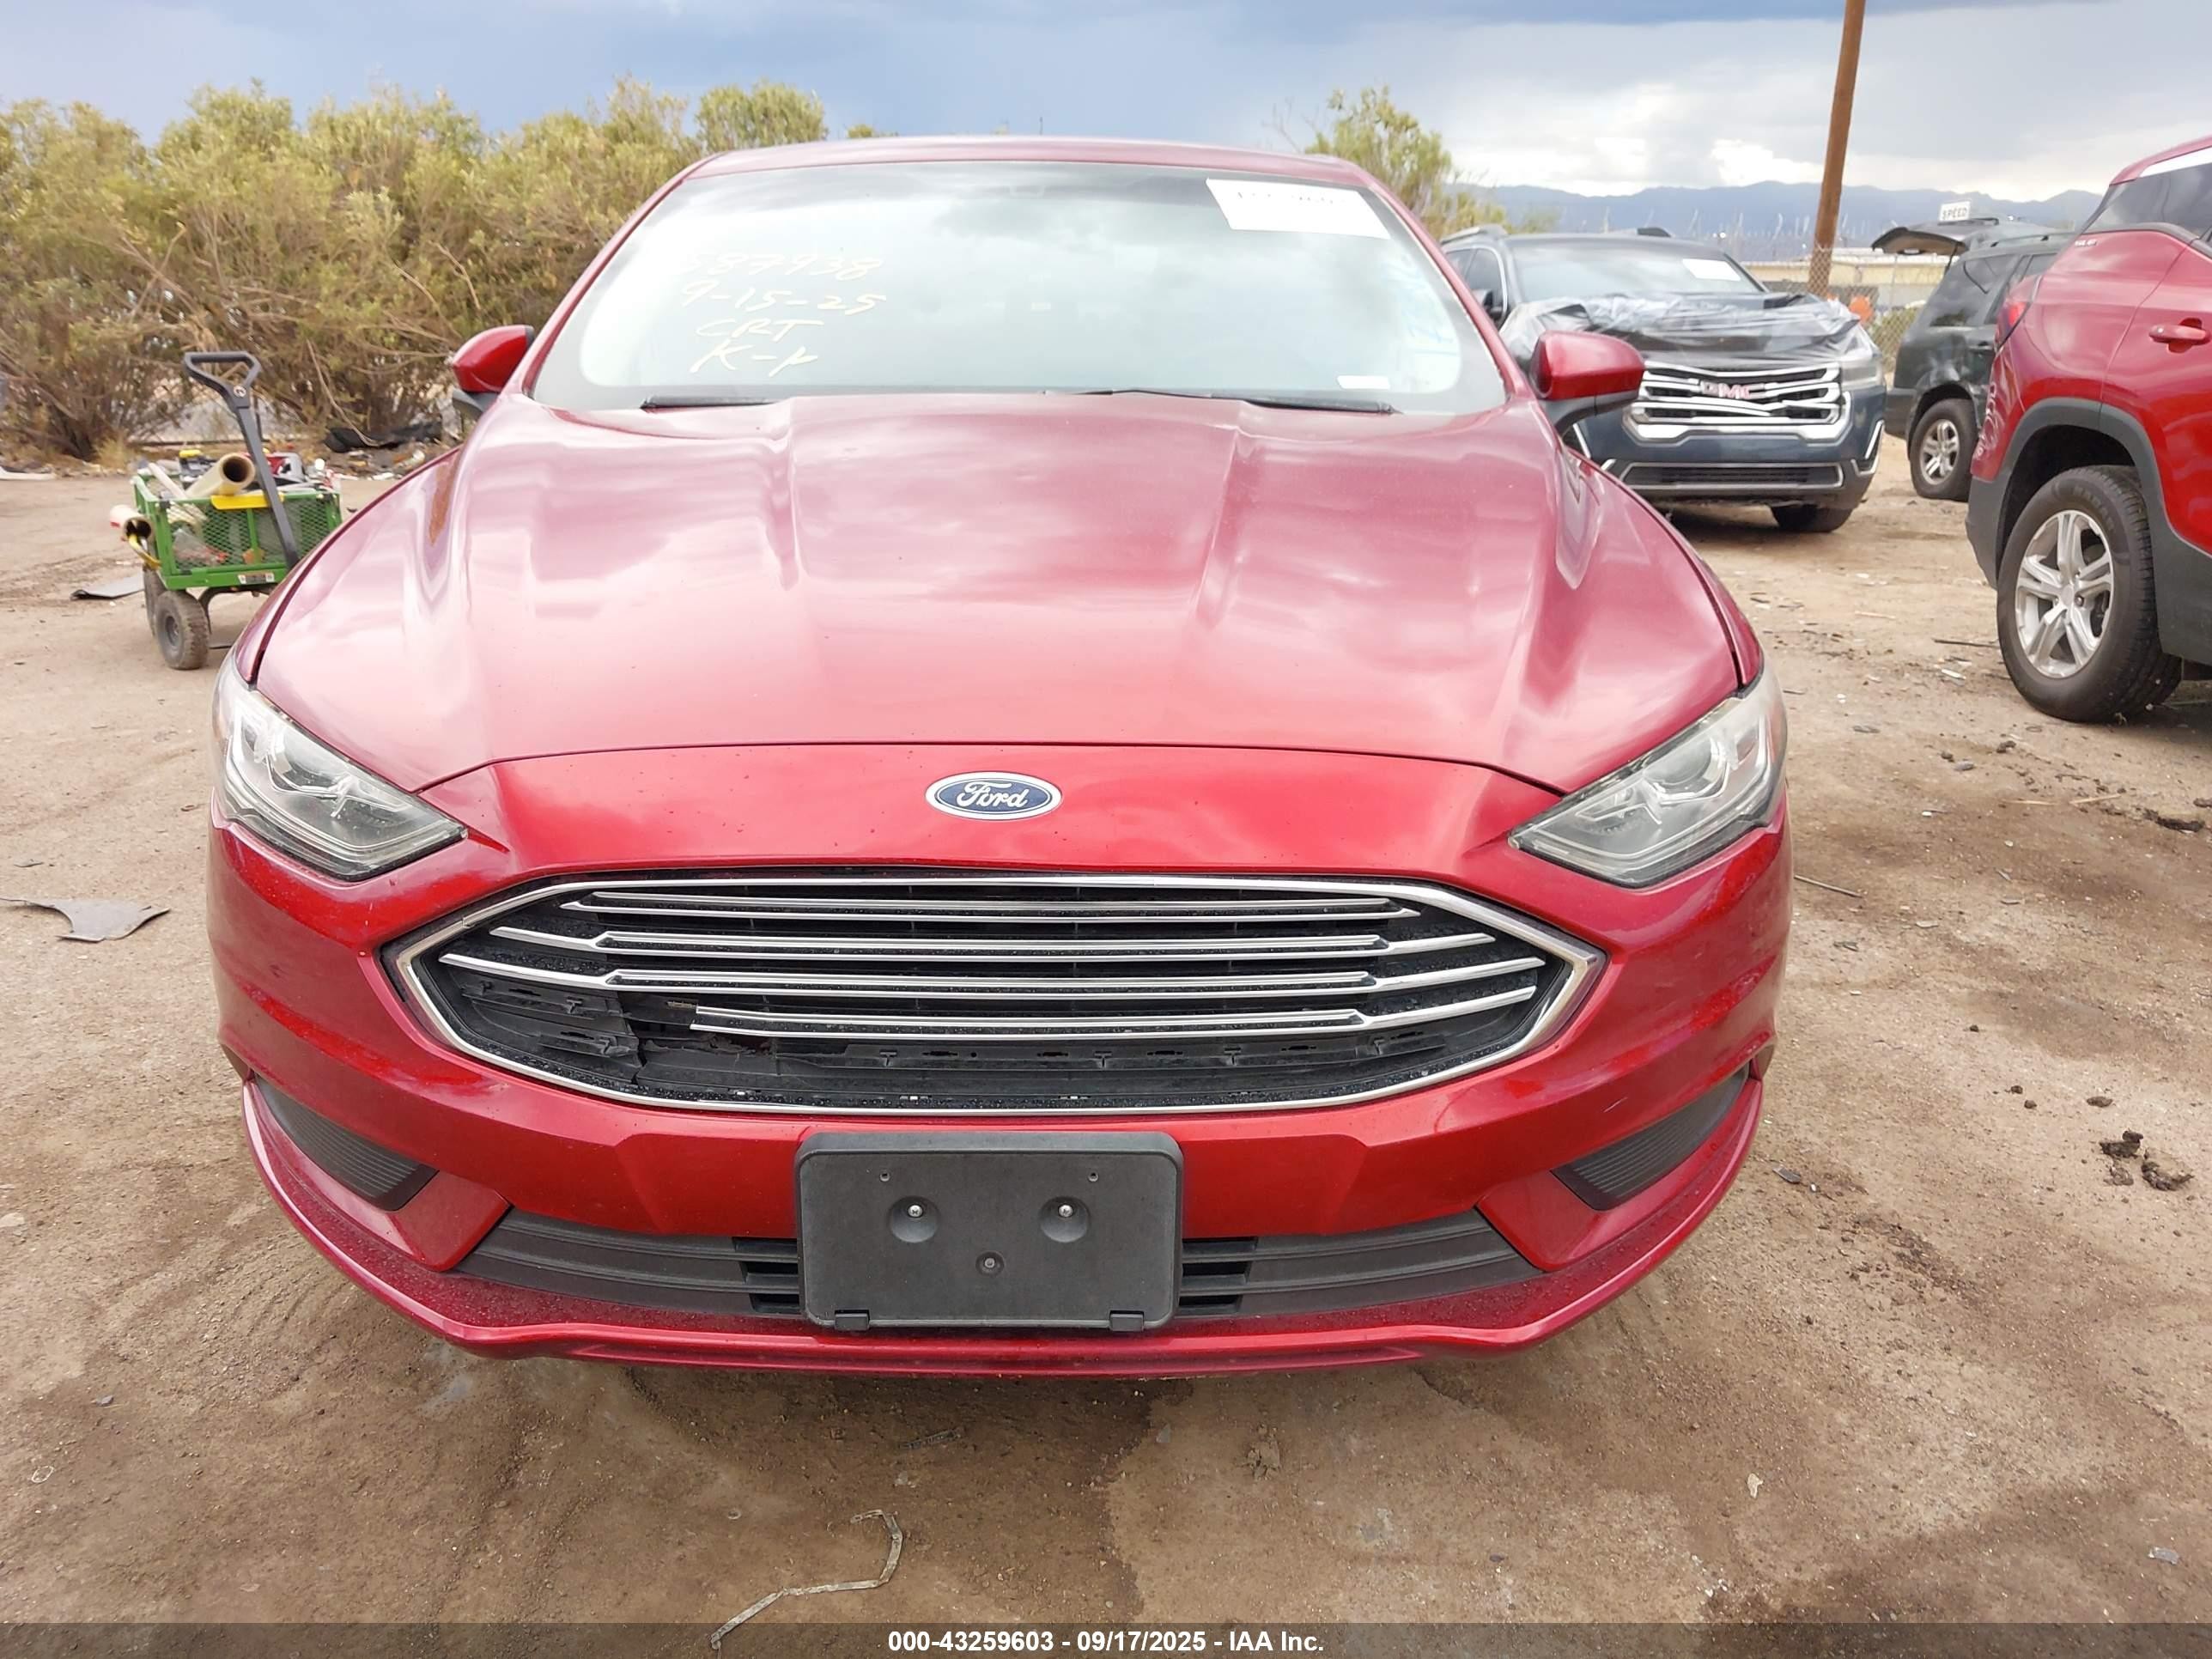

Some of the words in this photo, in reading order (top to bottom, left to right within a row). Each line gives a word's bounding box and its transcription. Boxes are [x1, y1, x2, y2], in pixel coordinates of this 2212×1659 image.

[681, 279, 887, 315] 9-15-25
[695, 318, 825, 343] CRT
[1700, 380, 1765, 400] GMC
[956, 781, 1030, 808] Ford
